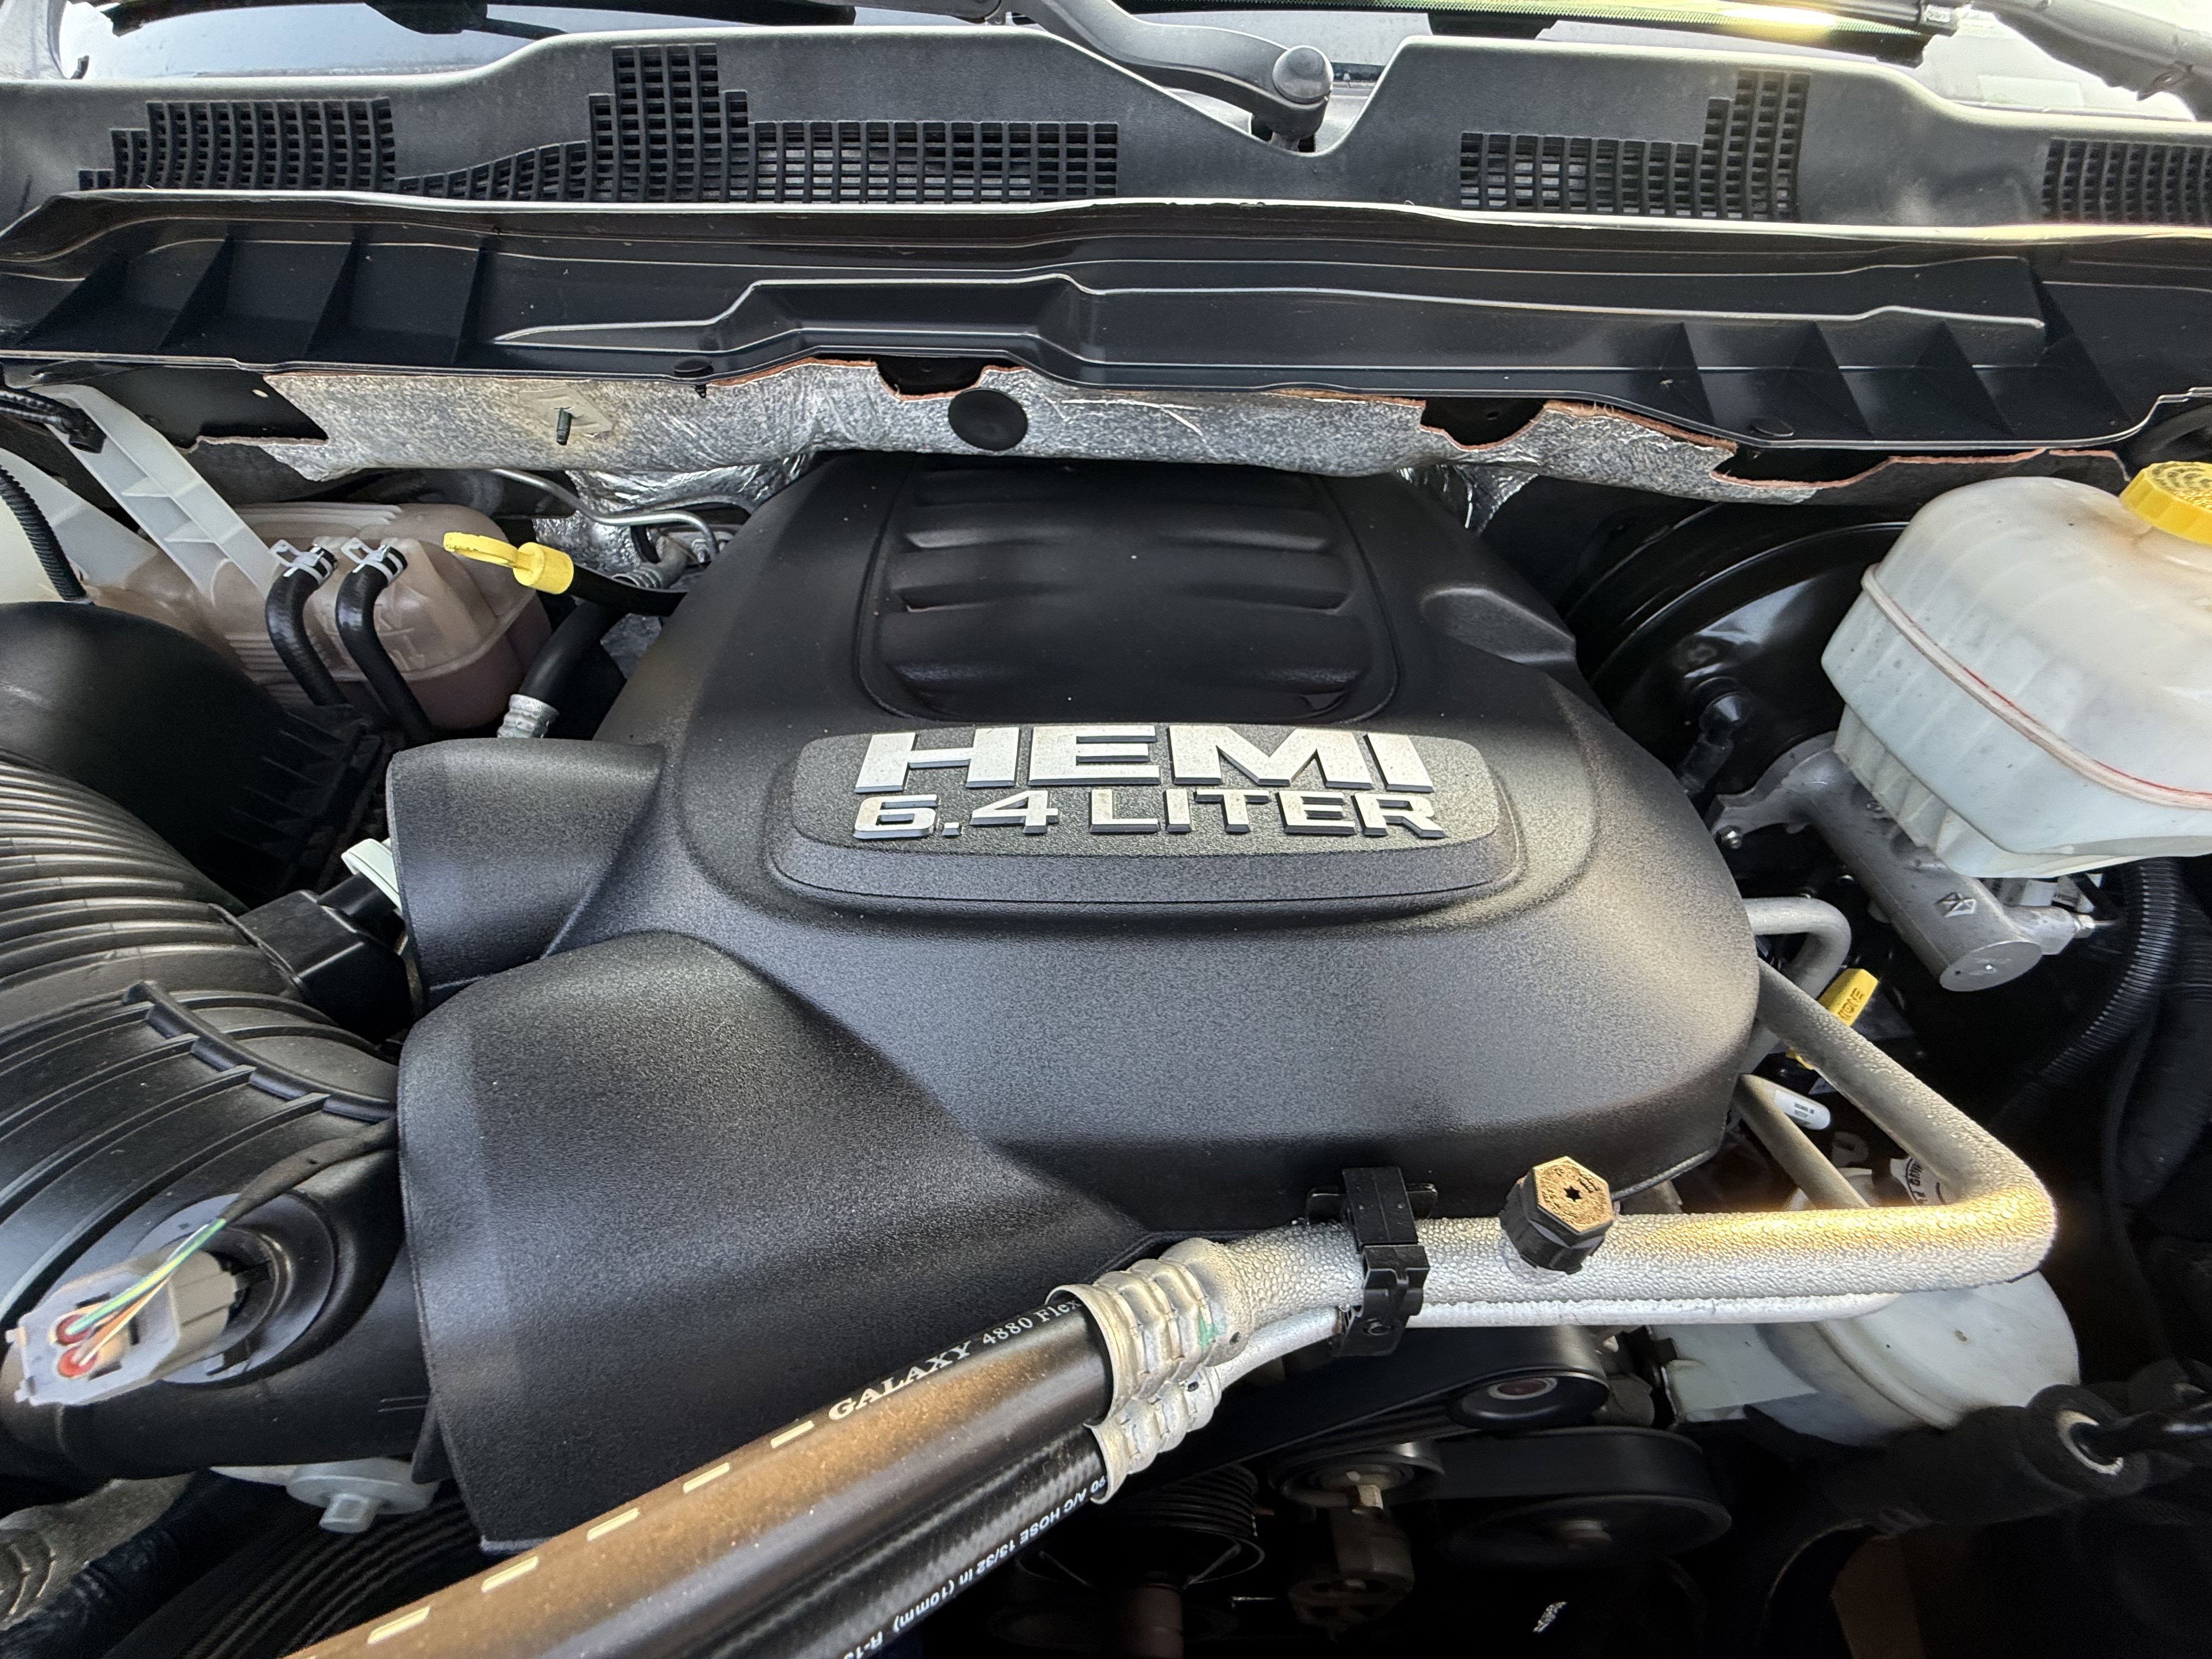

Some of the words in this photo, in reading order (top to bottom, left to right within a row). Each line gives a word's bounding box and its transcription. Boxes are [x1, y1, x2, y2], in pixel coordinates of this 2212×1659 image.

[854, 724, 1434, 793] HEMI
[853, 789, 1060, 838] 6.4
[1088, 788, 1447, 838] LITER
[828, 1340, 972, 1421] GALAXY
[982, 1317, 1034, 1346] 4880
[1032, 1299, 1082, 1323] Flex
[1018, 1506, 1061, 1543] HOSE
[1062, 1487, 1088, 1514] A/C
[975, 1539, 1017, 1576] 13/32
[891, 1579, 955, 1633] (10mm)
